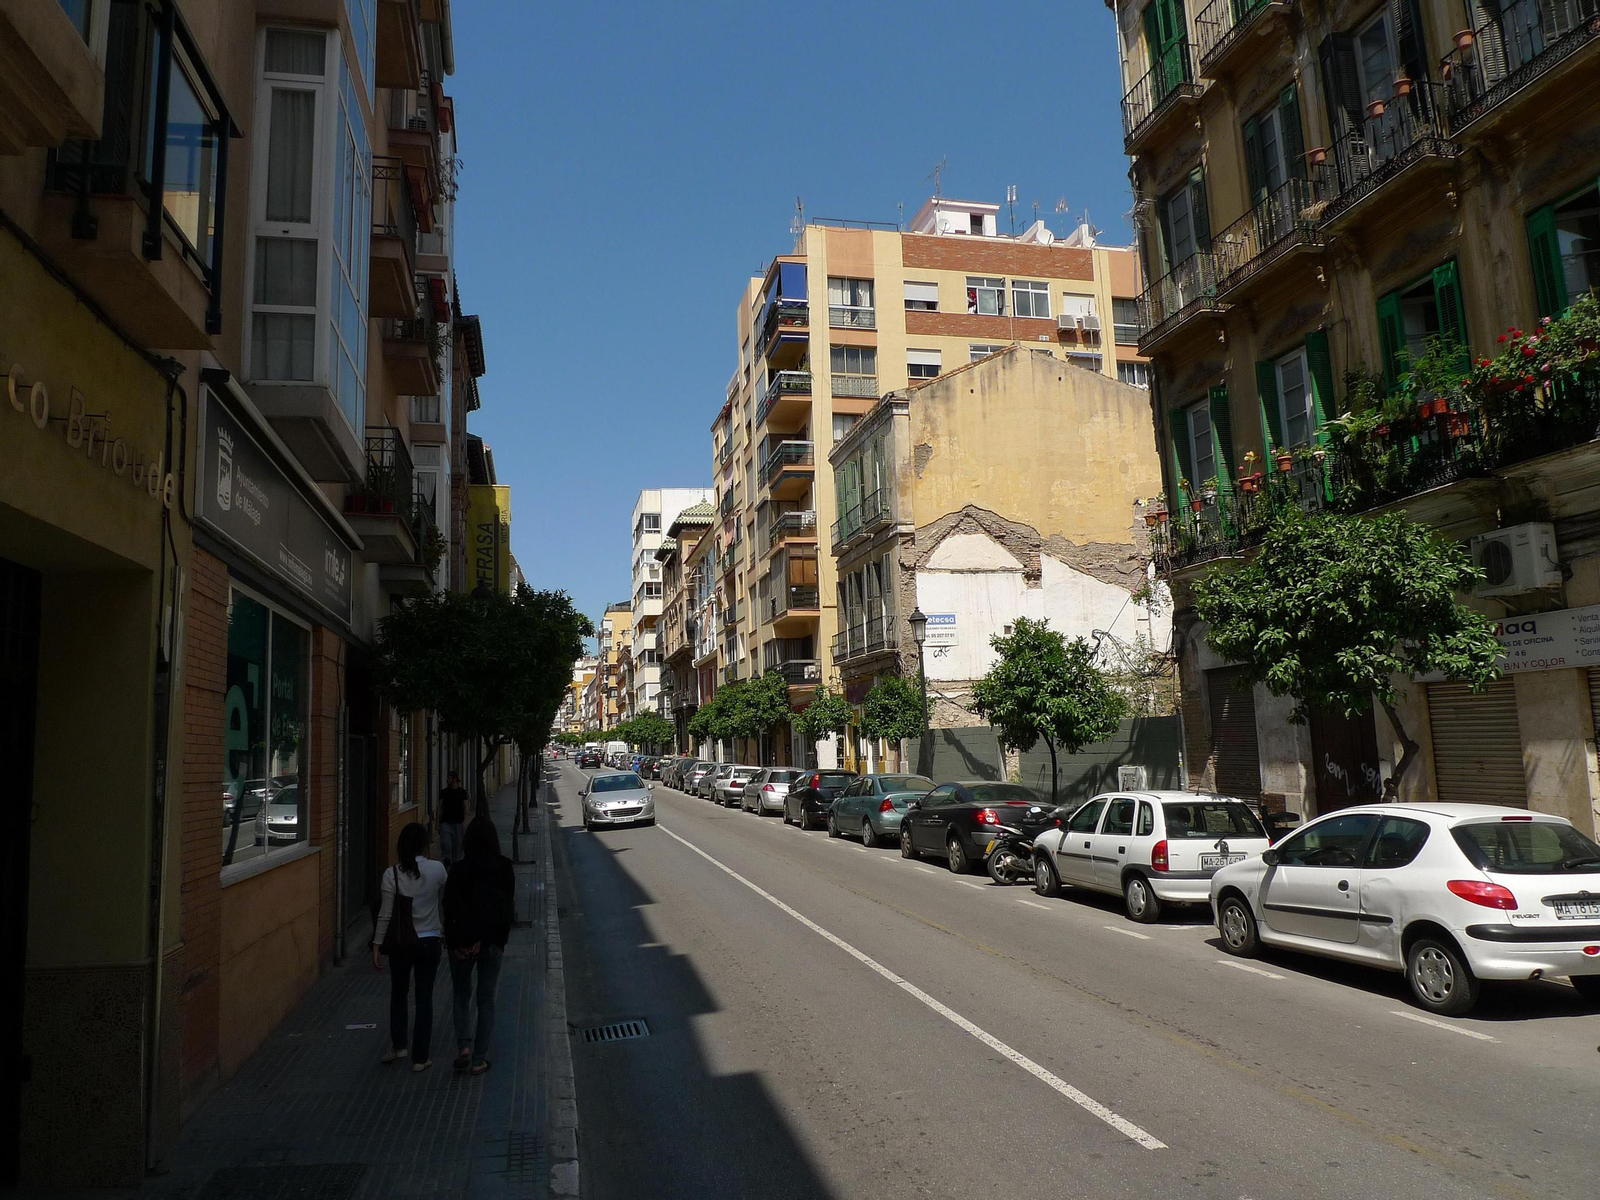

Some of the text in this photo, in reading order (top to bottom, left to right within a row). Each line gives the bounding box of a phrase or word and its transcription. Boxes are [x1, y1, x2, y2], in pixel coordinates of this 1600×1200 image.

[66, 385, 175, 509] Brioude
[236, 464, 269, 509] Ayuntamiento
[235, 491, 242, 508] de
[1524, 636, 1554, 645] OFICINA
[1504, 662, 1520, 670] B/N
[1530, 658, 1566, 668] COLOR
